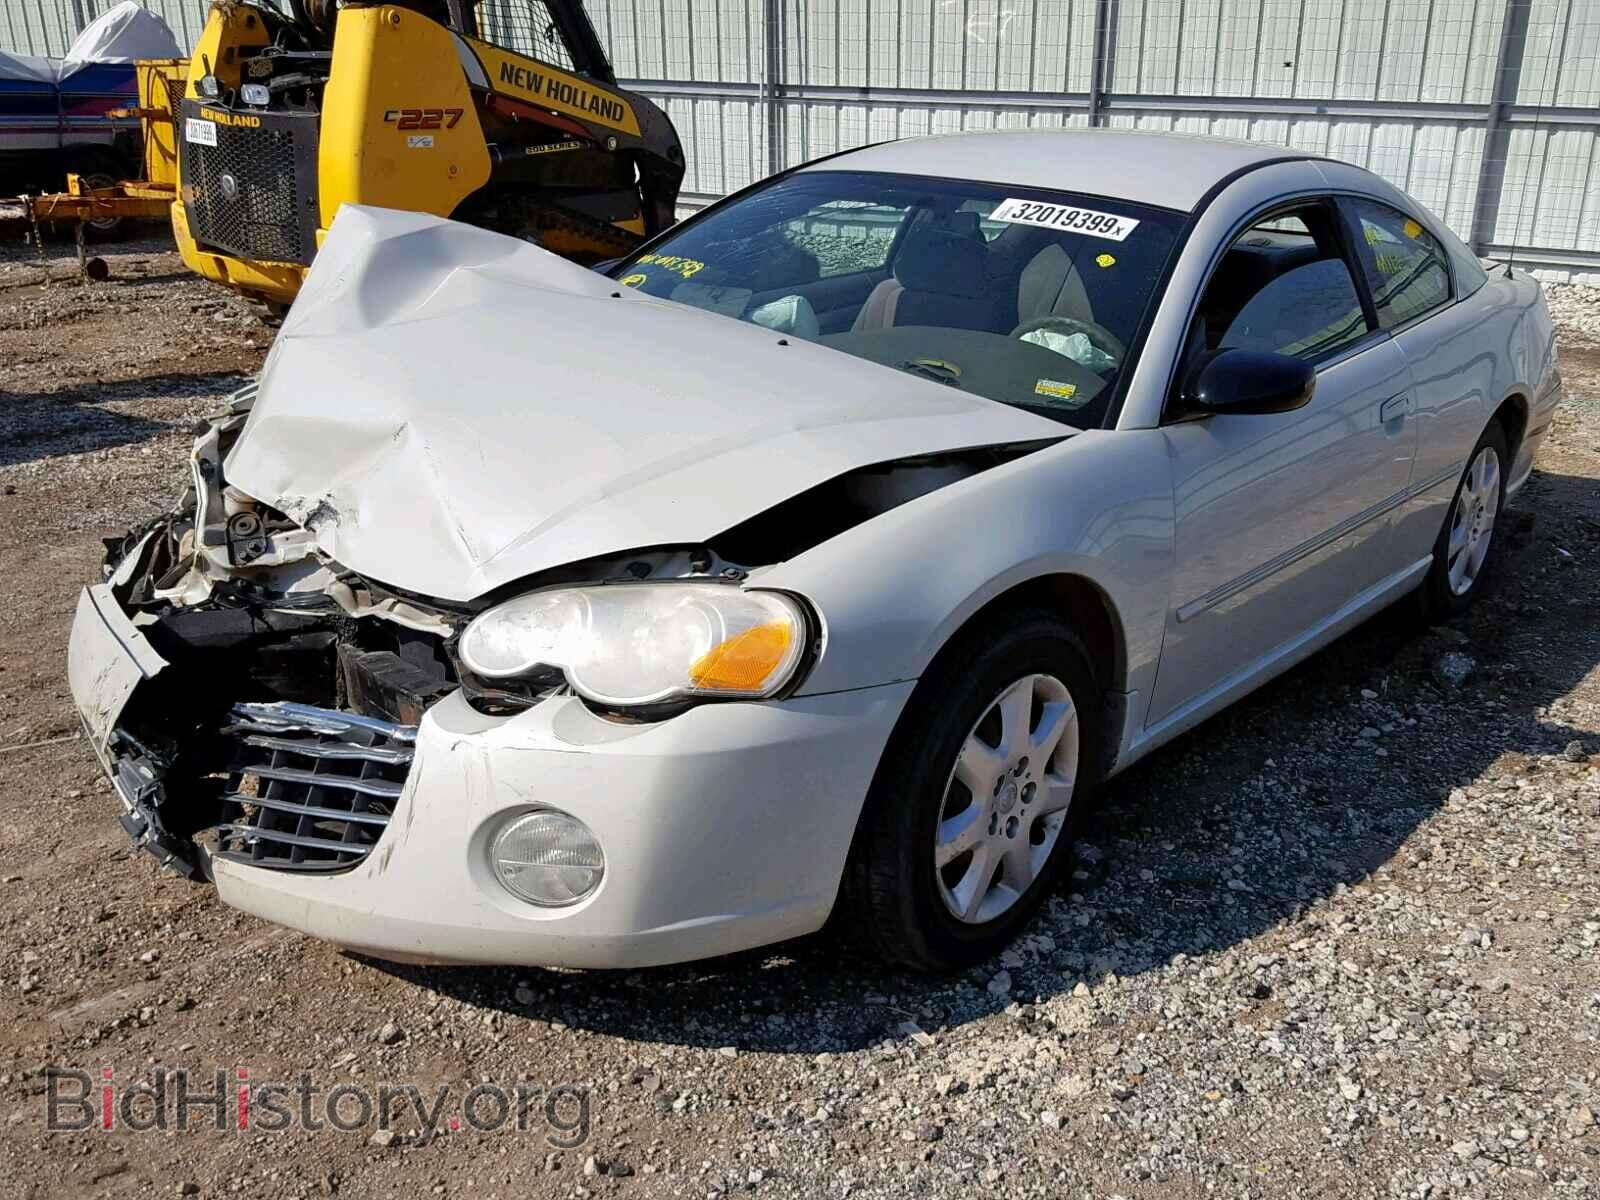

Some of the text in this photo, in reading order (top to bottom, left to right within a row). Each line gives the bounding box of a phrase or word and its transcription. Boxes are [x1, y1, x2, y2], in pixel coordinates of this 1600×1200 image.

[500, 61, 625, 122] NEW HOLLAND
[201, 107, 260, 128] NEW HOLLAND
[383, 109, 464, 130] C227
